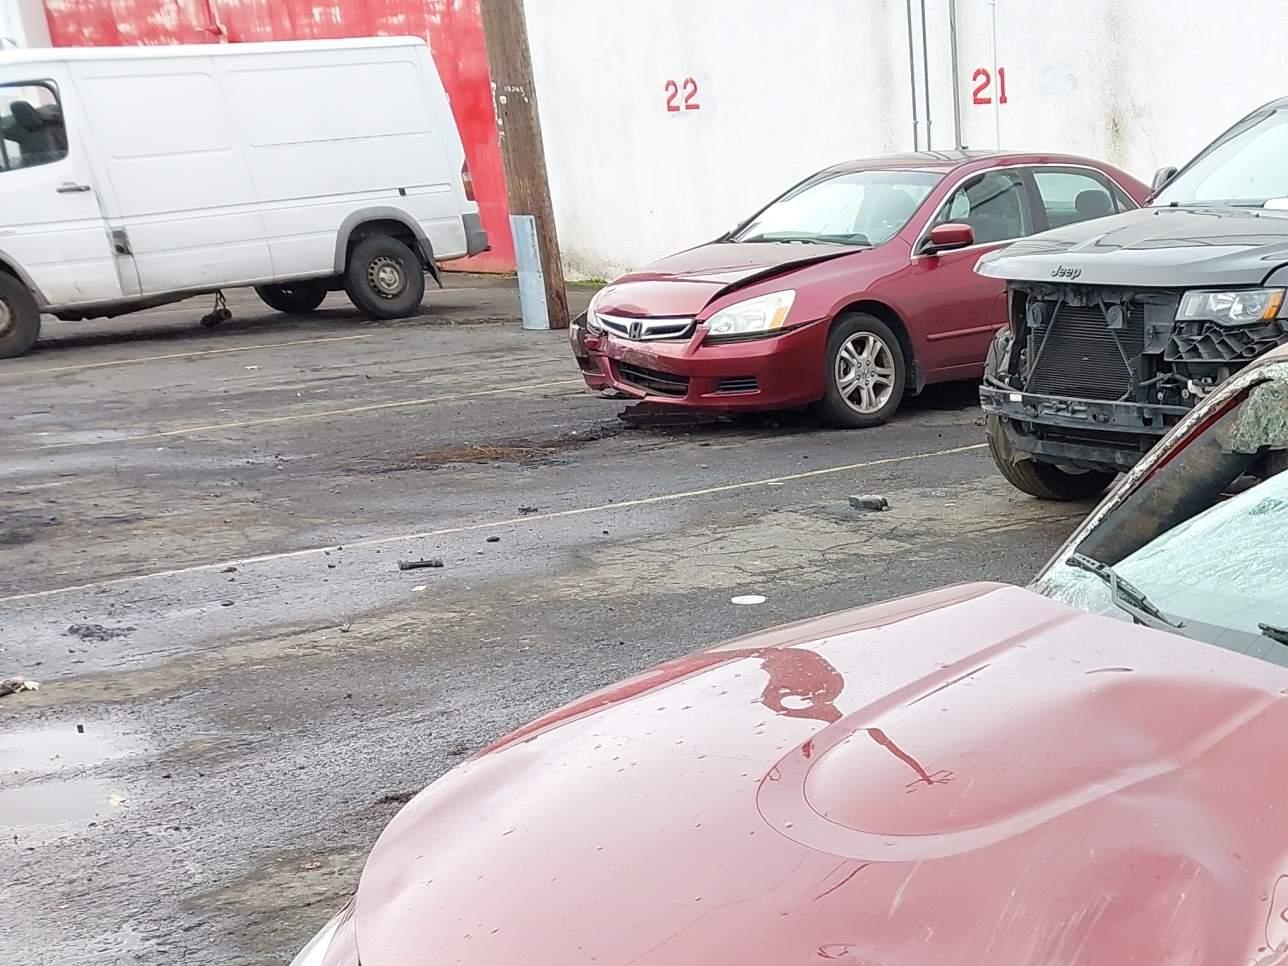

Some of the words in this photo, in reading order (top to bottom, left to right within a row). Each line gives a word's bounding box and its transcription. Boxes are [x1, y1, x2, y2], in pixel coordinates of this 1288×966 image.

[665, 77, 700, 112] 22
[972, 67, 1008, 104] 21
[1050, 264, 1082, 281] Jeep
